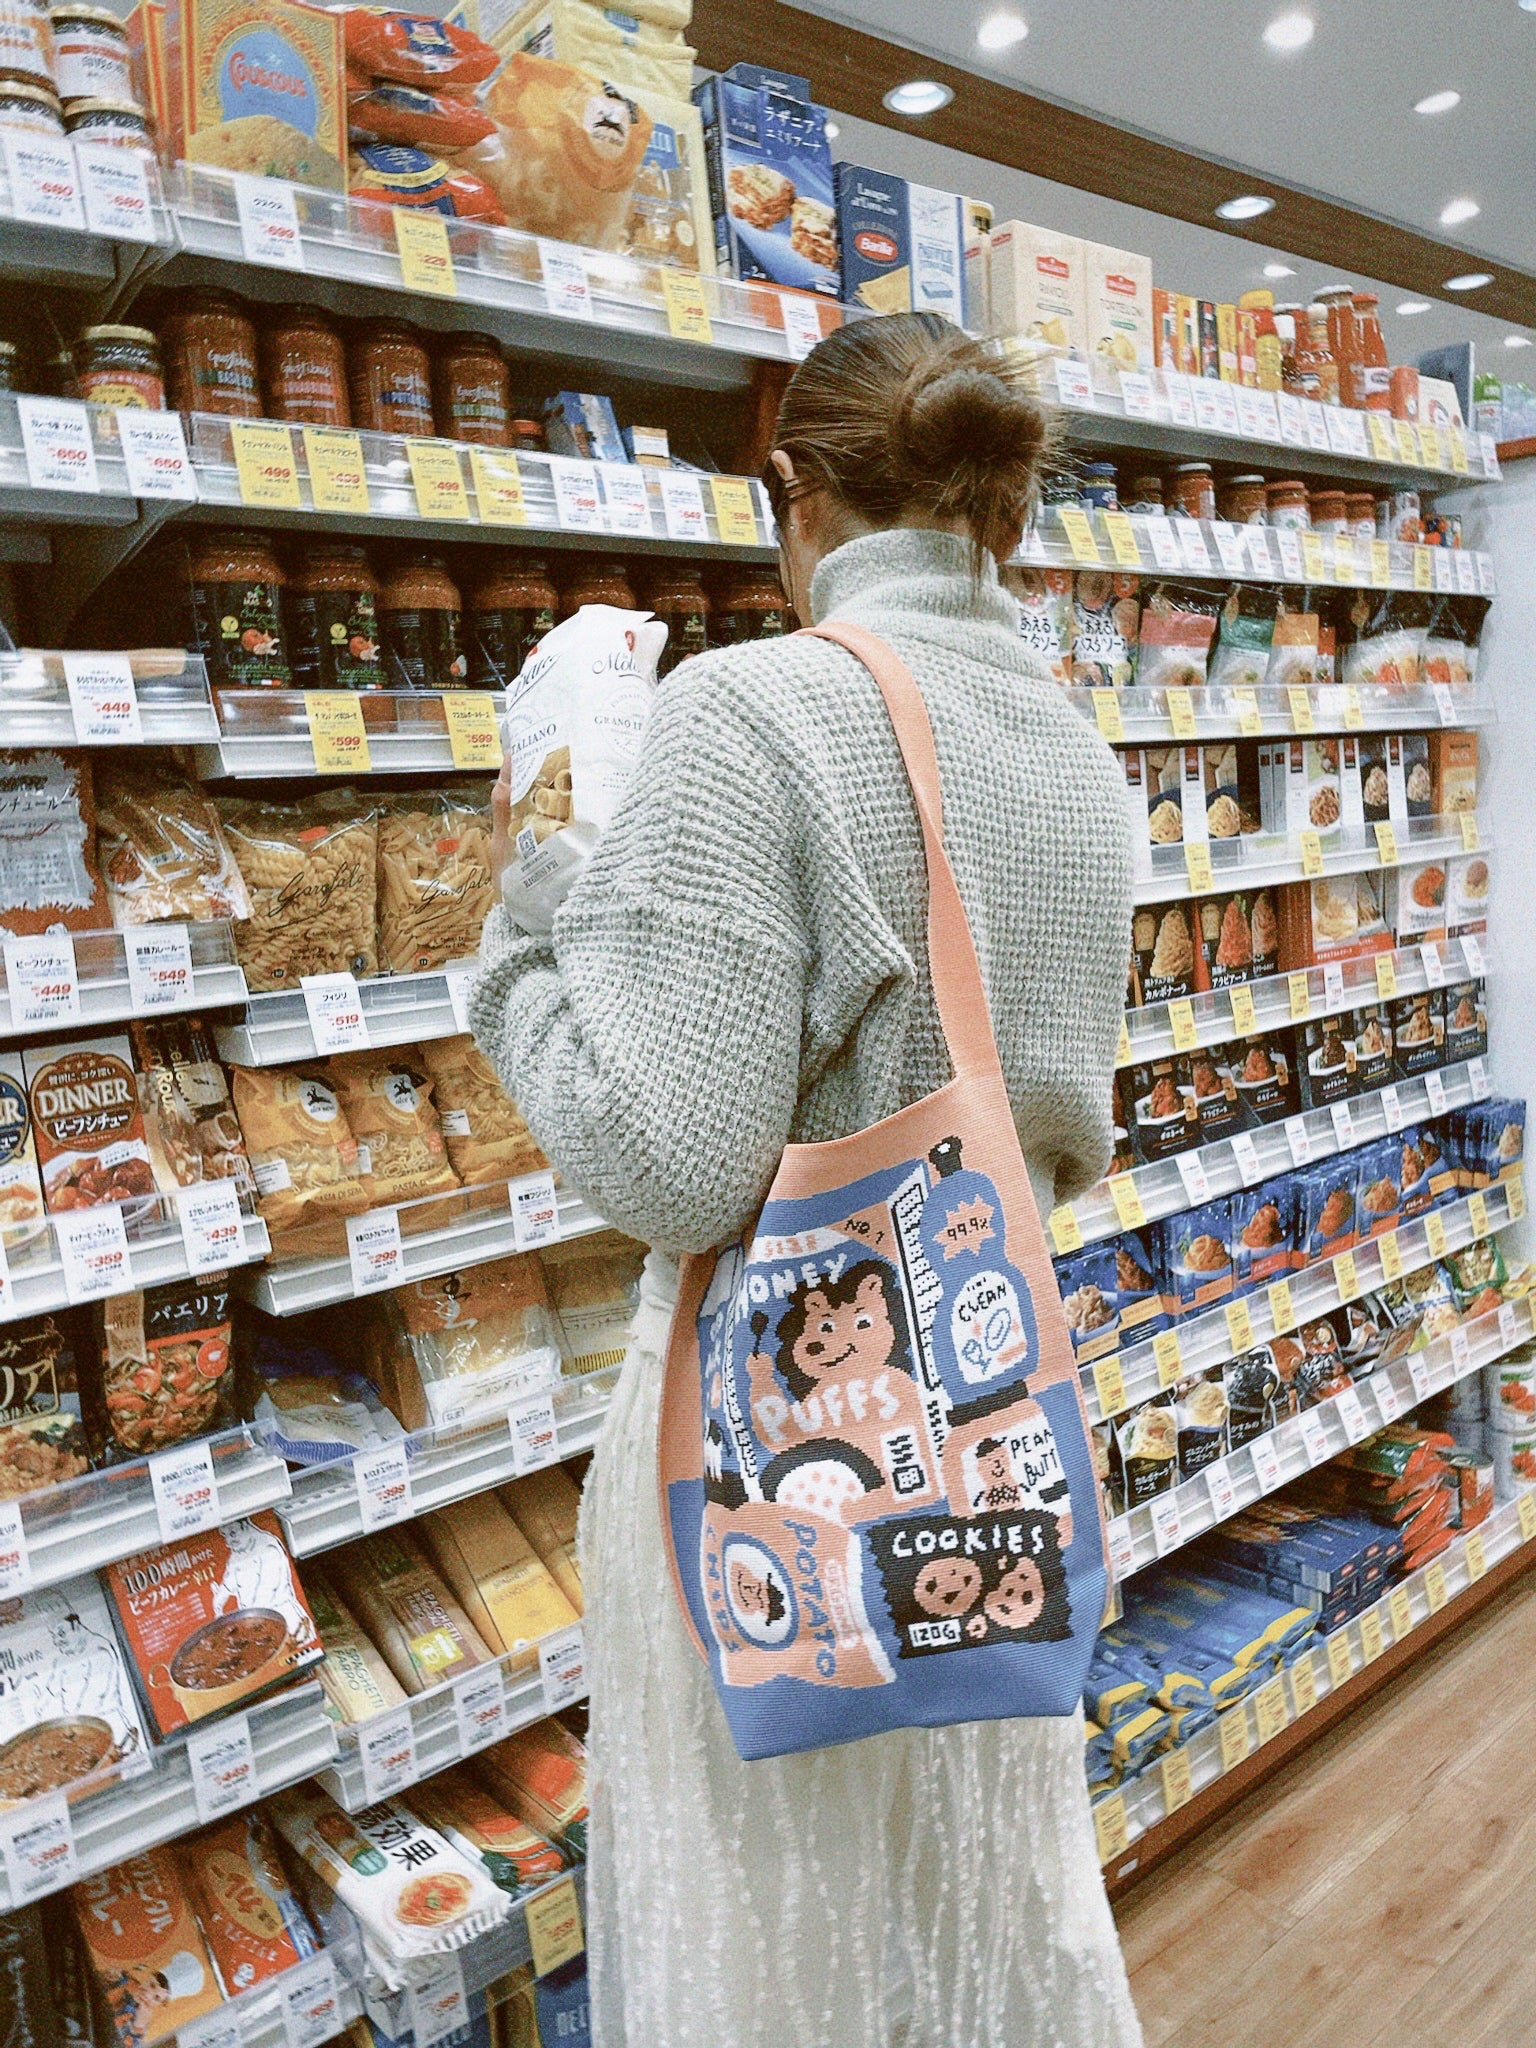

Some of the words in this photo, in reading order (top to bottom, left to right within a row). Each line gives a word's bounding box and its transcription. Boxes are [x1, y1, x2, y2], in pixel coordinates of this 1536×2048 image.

[102, 702, 131, 713] 449
[335, 736, 361, 747] 599
[471, 733, 493, 744] 599
[158, 968, 187, 982] 549
[41, 983, 71, 996] 449
[335, 1014, 359, 1026] 519
[37, 1076, 133, 1119] DINNER
[54, 1111, 129, 1139] ビーフシチュー
[211, 1225, 238, 1239] 439
[373, 1249, 397, 1264] 299
[150, 1292, 230, 1324] パエリア
[958, 1282, 1008, 1322] CLEAN
[753, 1373, 902, 1443] PUFFS
[892, 1523, 1045, 1558] COOKIES
[783, 1519, 837, 1679] POTATO
[912, 1624, 957, 1642] 120G
